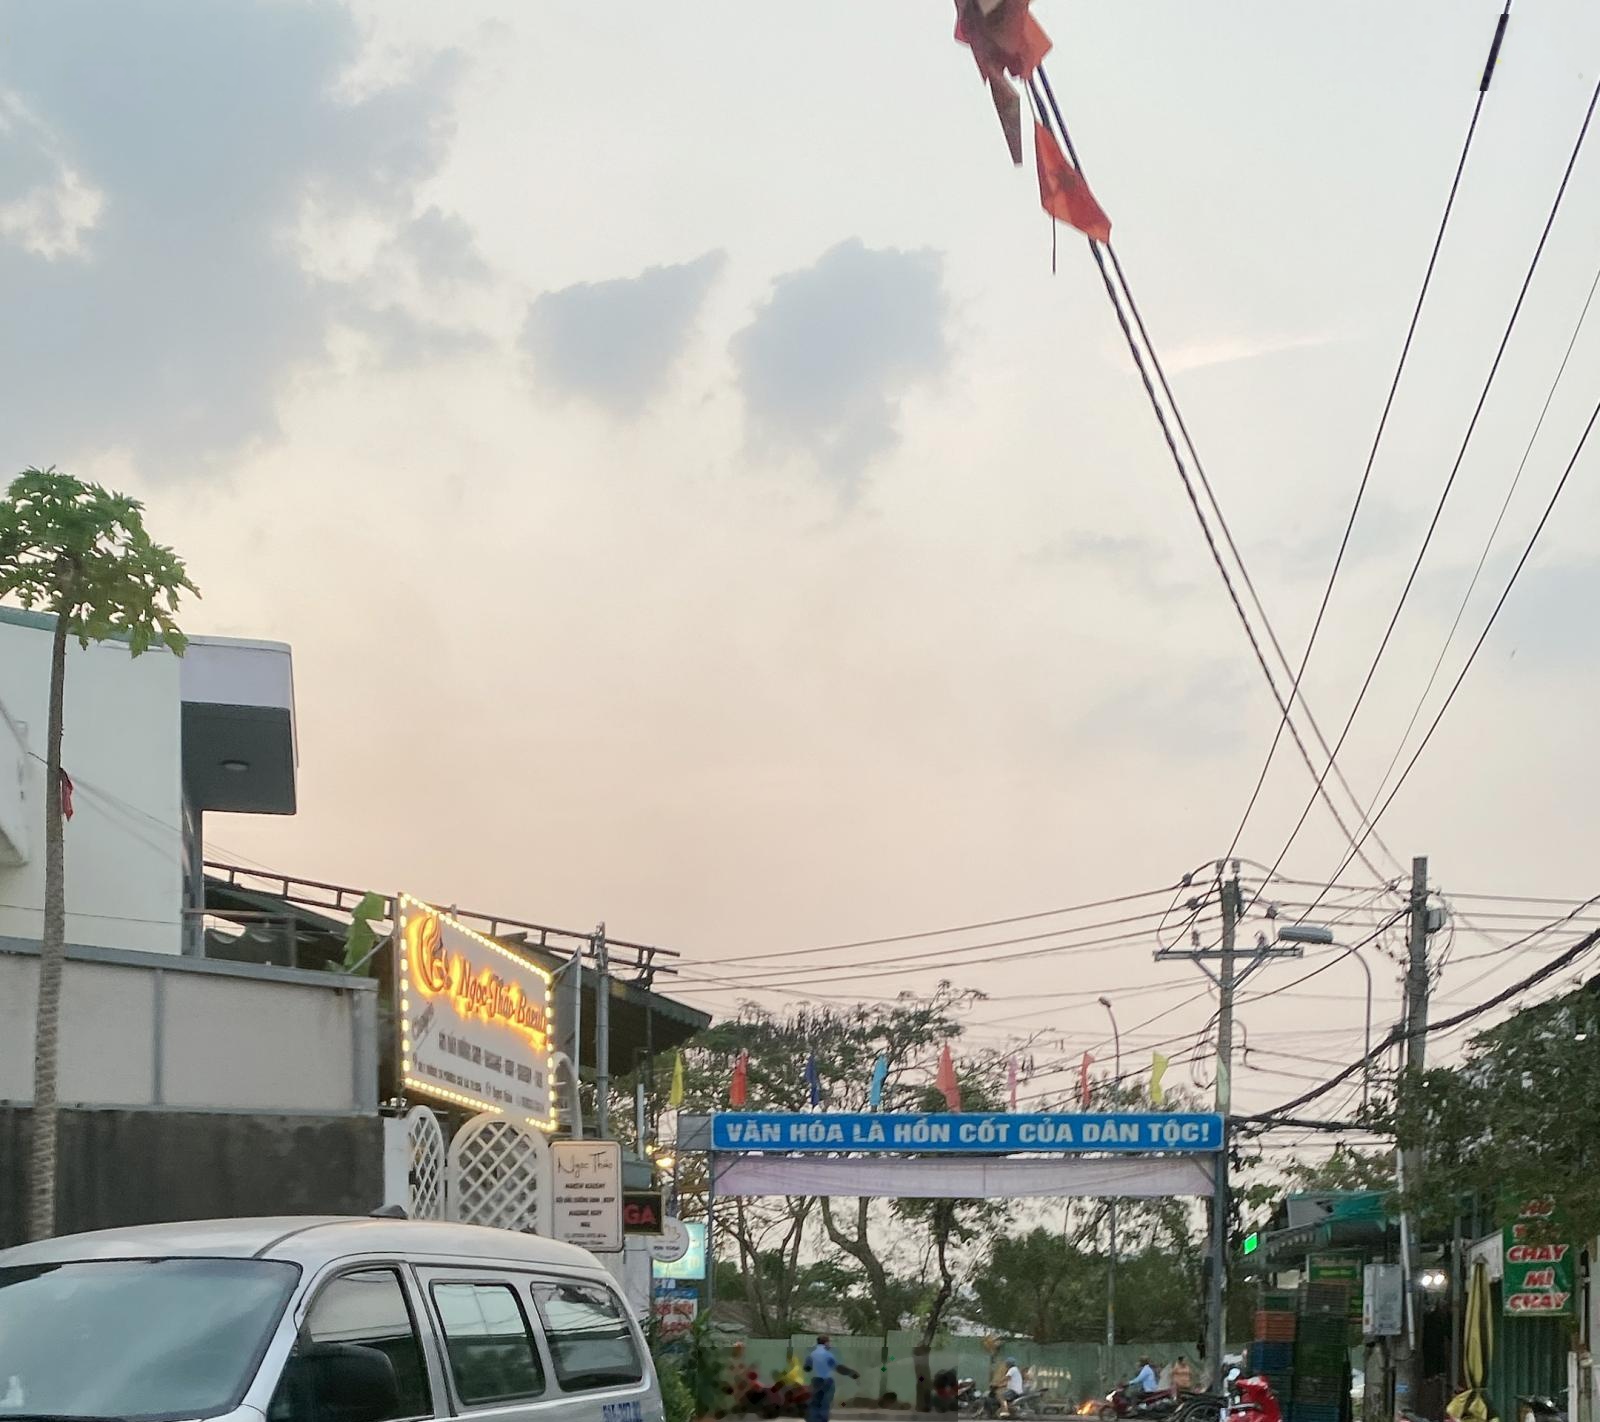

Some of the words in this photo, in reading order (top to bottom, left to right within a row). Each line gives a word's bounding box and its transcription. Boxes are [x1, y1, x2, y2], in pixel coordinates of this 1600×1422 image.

[726, 1119, 781, 1142] VĂN
[790, 1119, 844, 1142] HÓA
[853, 1119, 886, 1142] LÀ
[893, 1117, 950, 1142] HỒN
[959, 1117, 1010, 1142] CỐT
[1018, 1117, 1074, 1143] CỦA
[1082, 1119, 1139, 1143] DÂN
[1148, 1119, 1209, 1146] TỘC!
[1507, 1244, 1570, 1263] CHAY
[1507, 1292, 1571, 1312] CHAY
